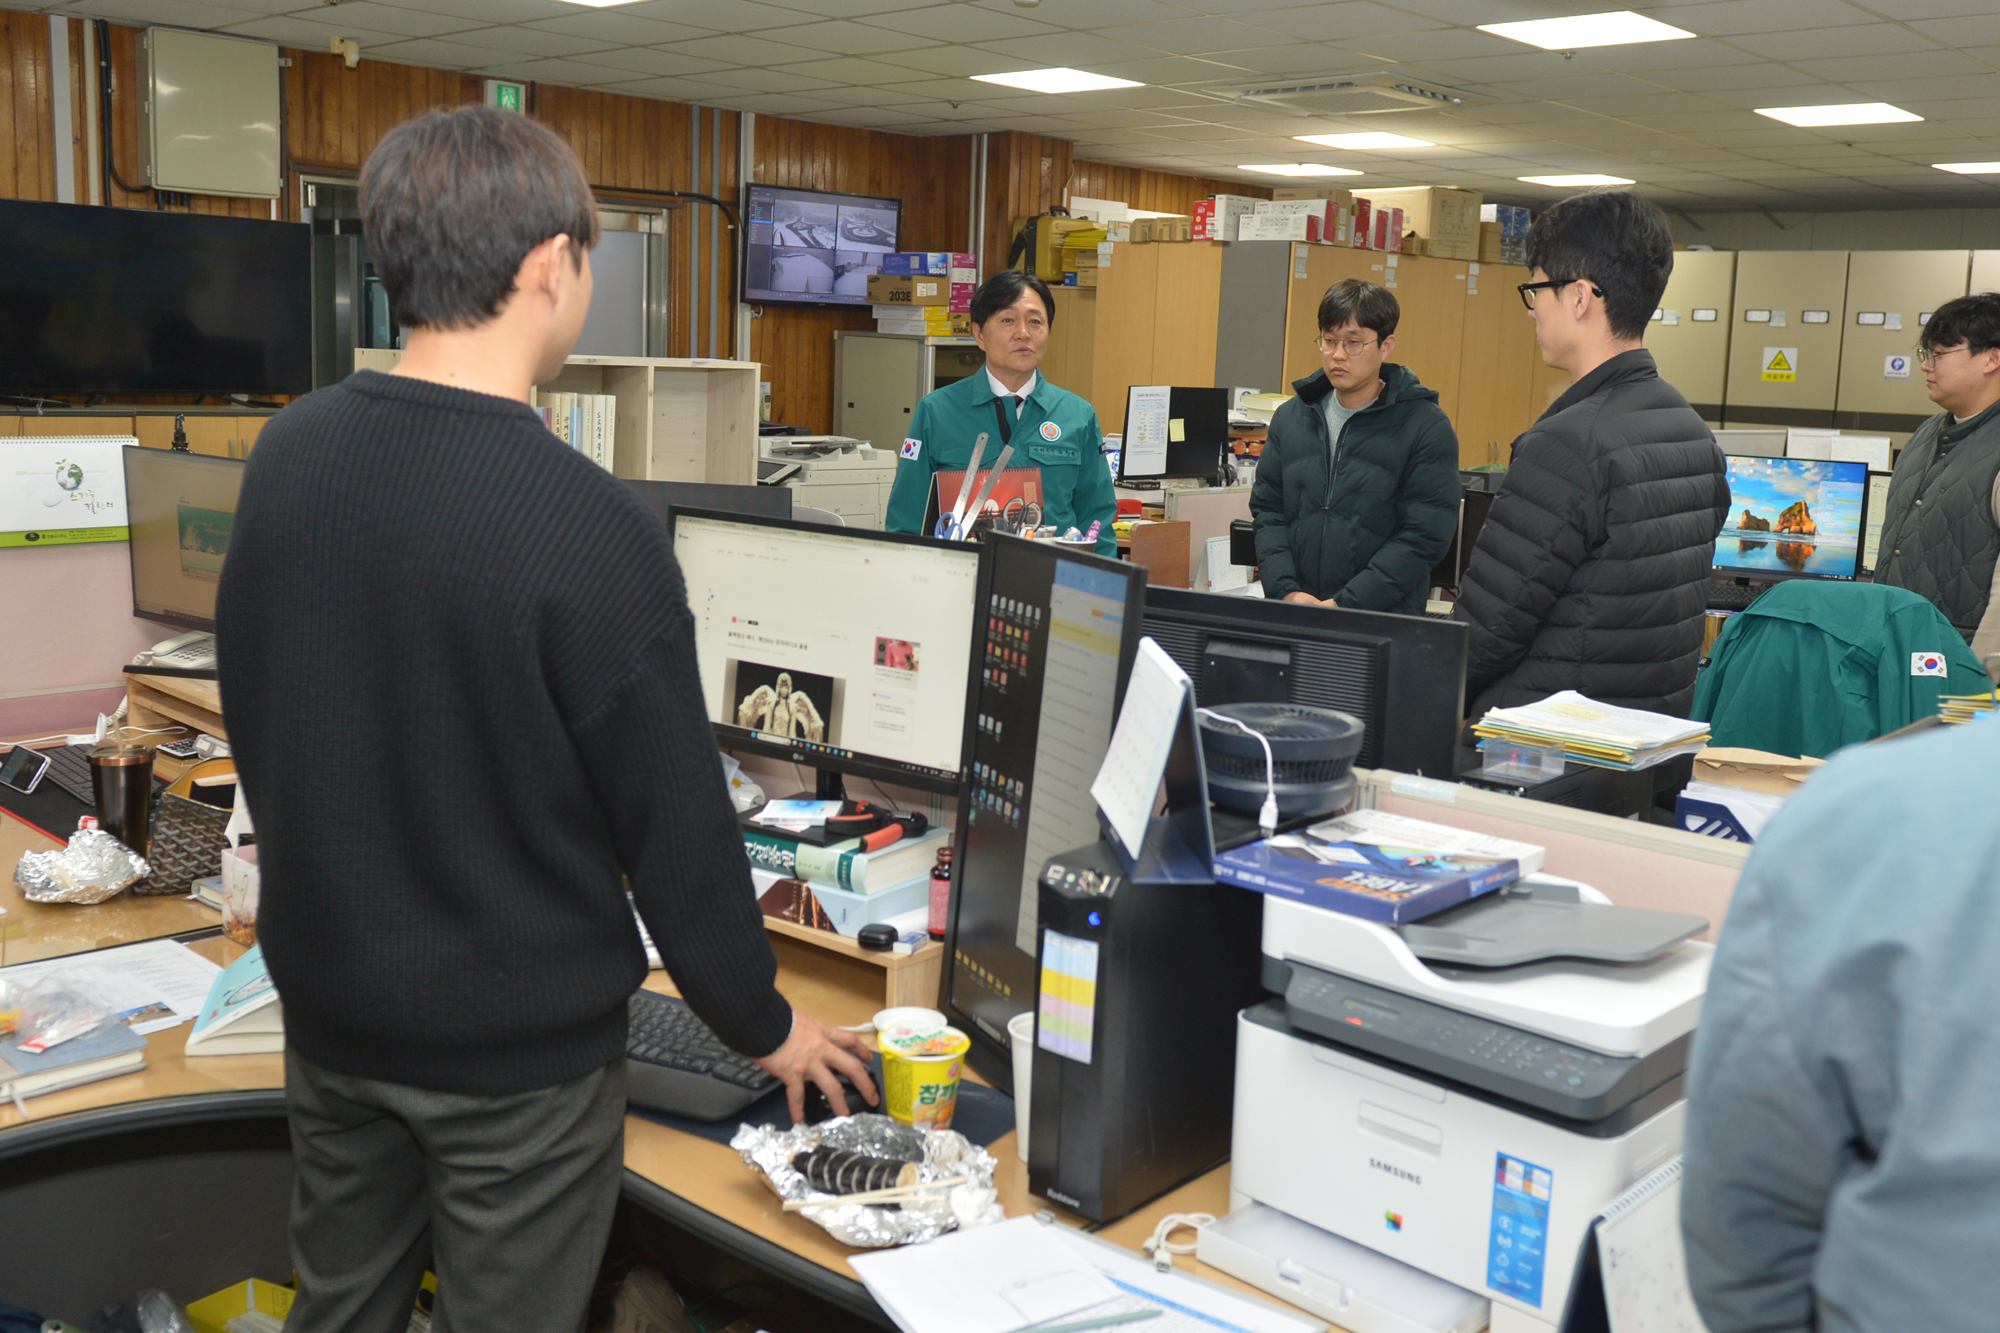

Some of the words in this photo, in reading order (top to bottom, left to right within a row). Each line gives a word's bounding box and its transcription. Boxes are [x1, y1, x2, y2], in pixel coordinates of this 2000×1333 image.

[889, 291, 912, 302] 203E
[1341, 870, 1433, 895] LABEL
[1369, 1158, 1422, 1186] SAMSUNG
